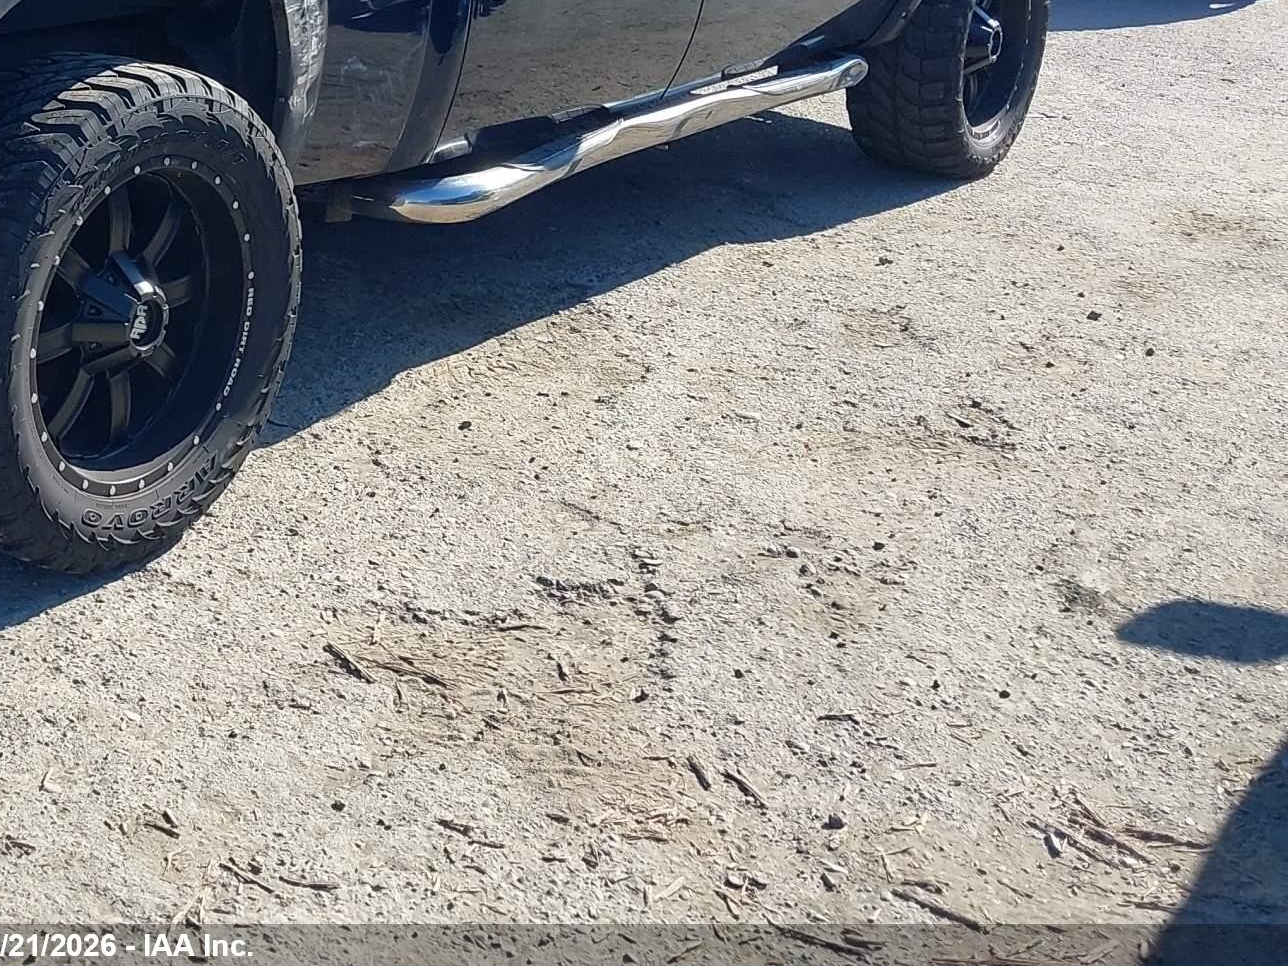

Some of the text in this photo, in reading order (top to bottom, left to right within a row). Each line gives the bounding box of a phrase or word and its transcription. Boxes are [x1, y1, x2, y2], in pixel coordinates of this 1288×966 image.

[222, 288, 254, 397] RED DIRT ROAD
